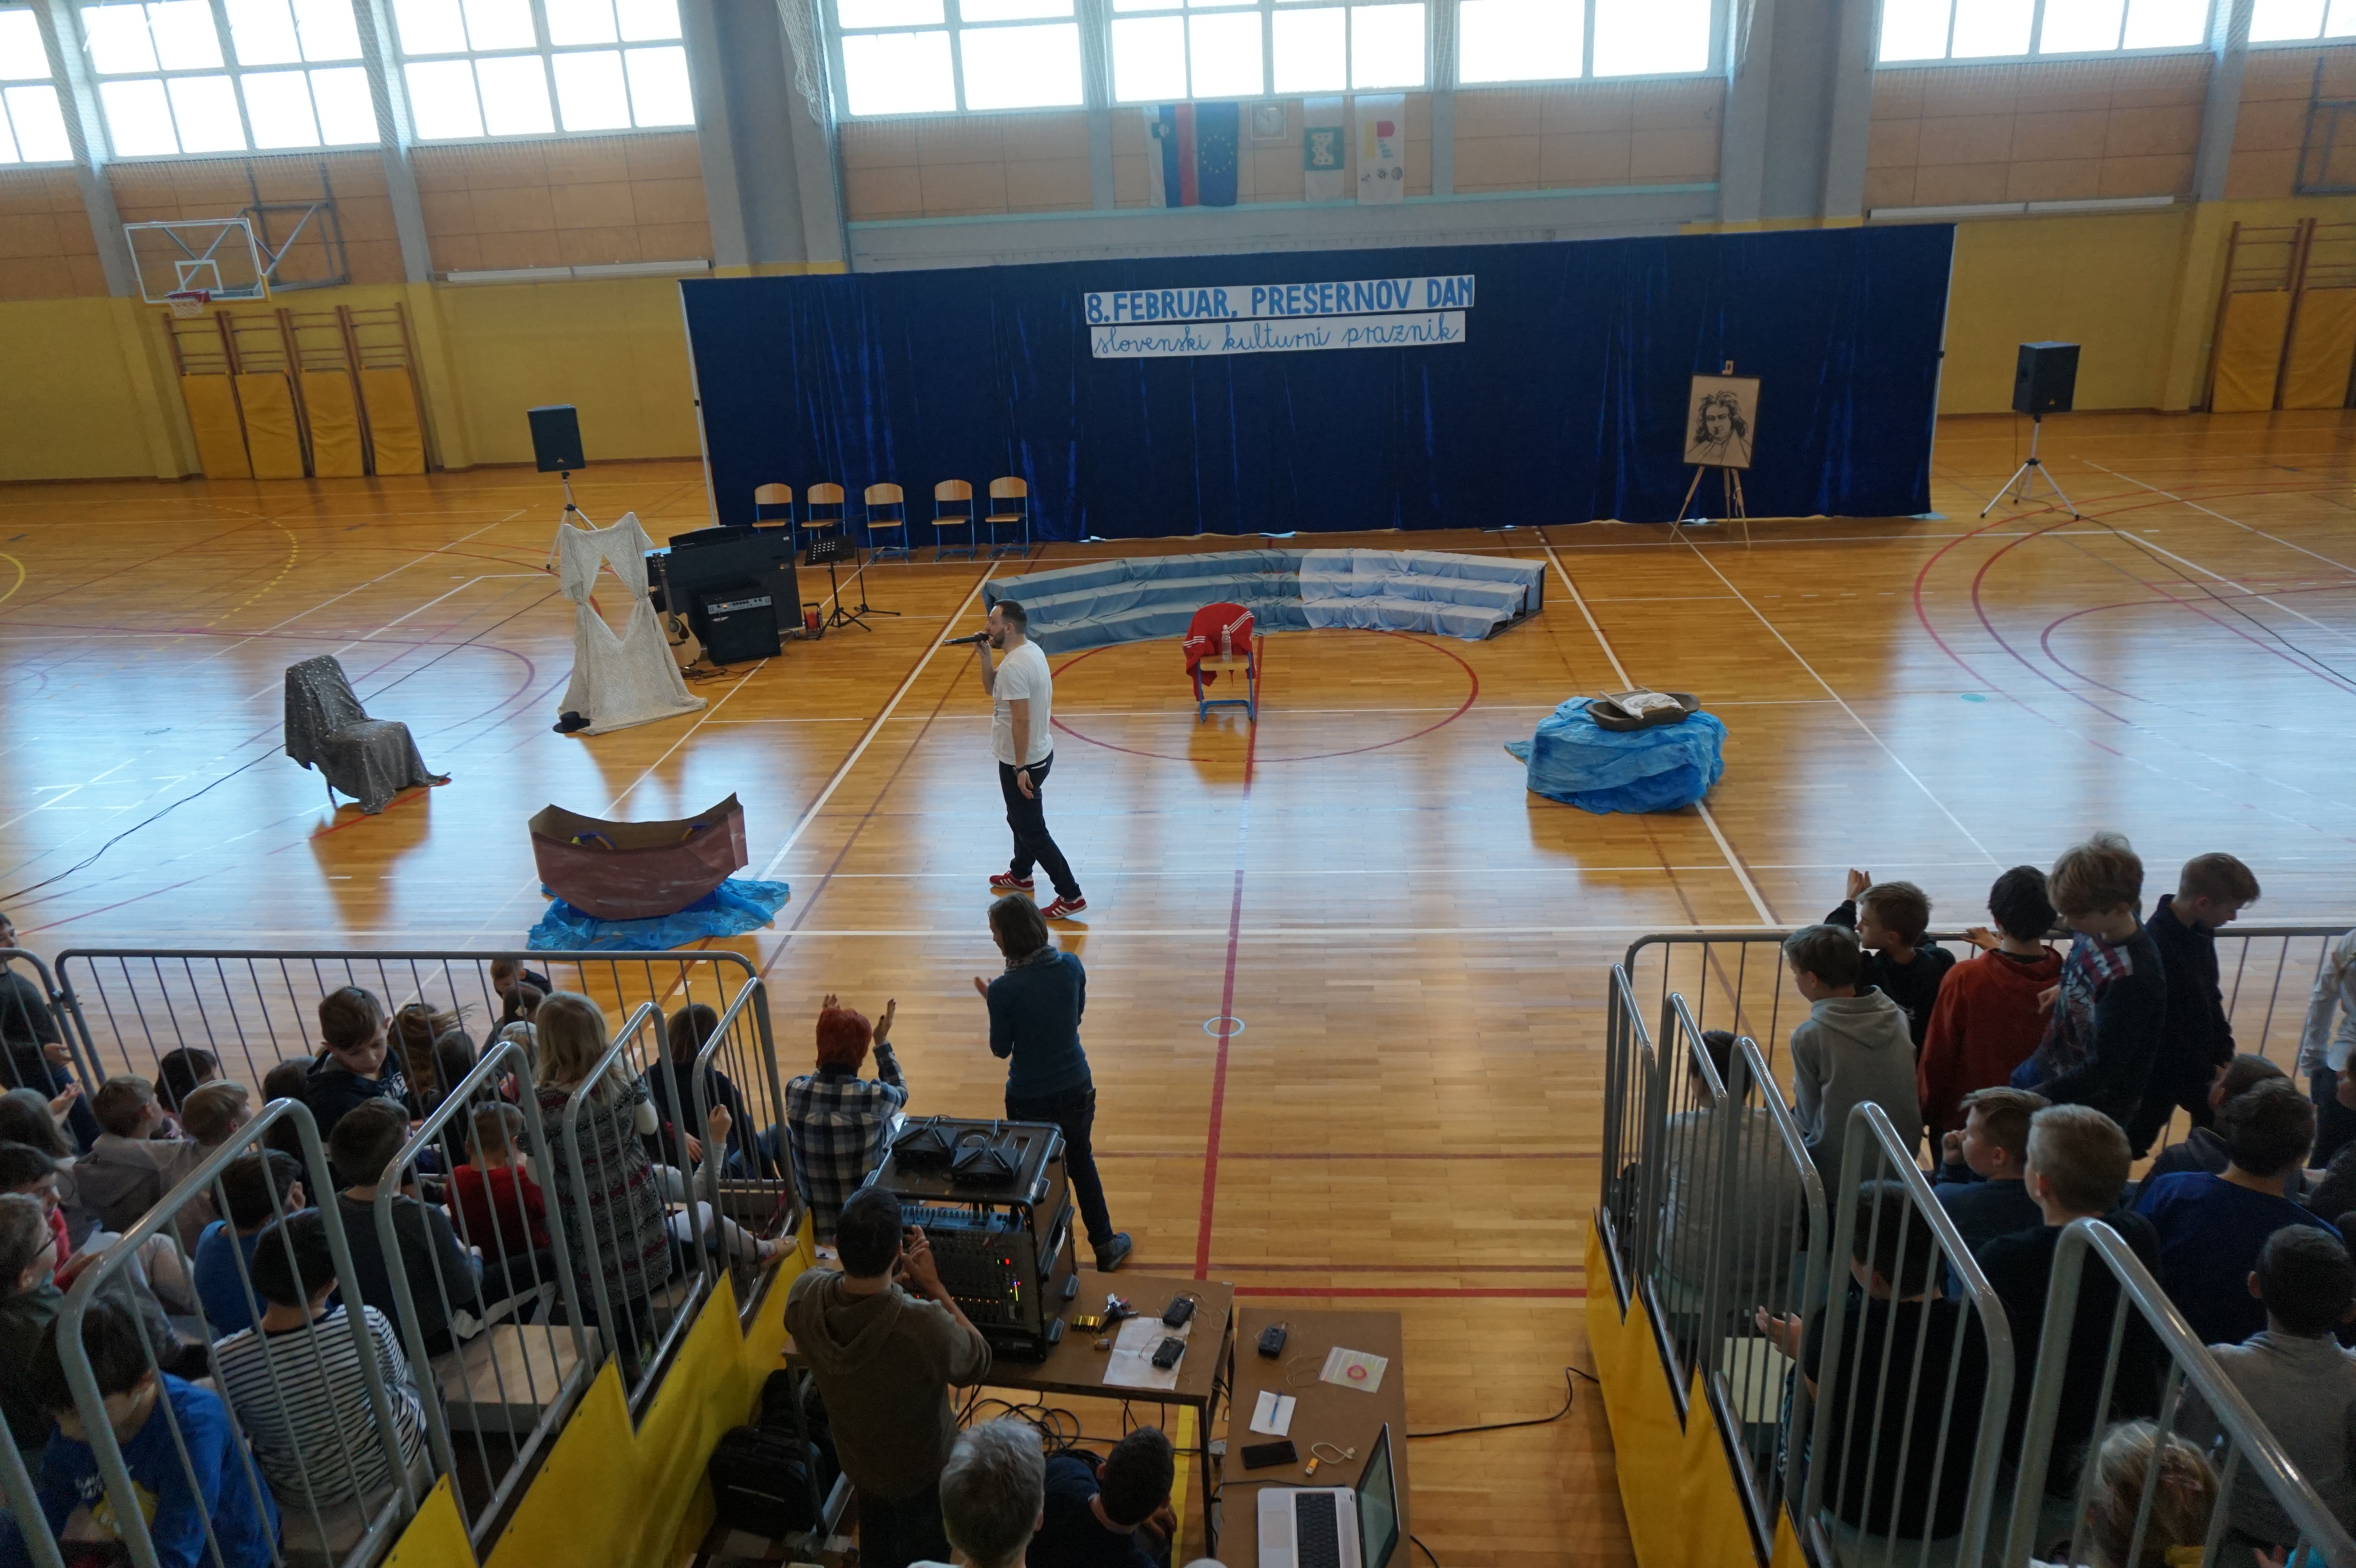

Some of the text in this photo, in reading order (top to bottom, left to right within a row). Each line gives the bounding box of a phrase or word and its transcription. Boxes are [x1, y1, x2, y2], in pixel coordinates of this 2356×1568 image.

[1427, 277, 1473, 308] DAN
[1095, 313, 1459, 353] slovenski kulturni praznik
